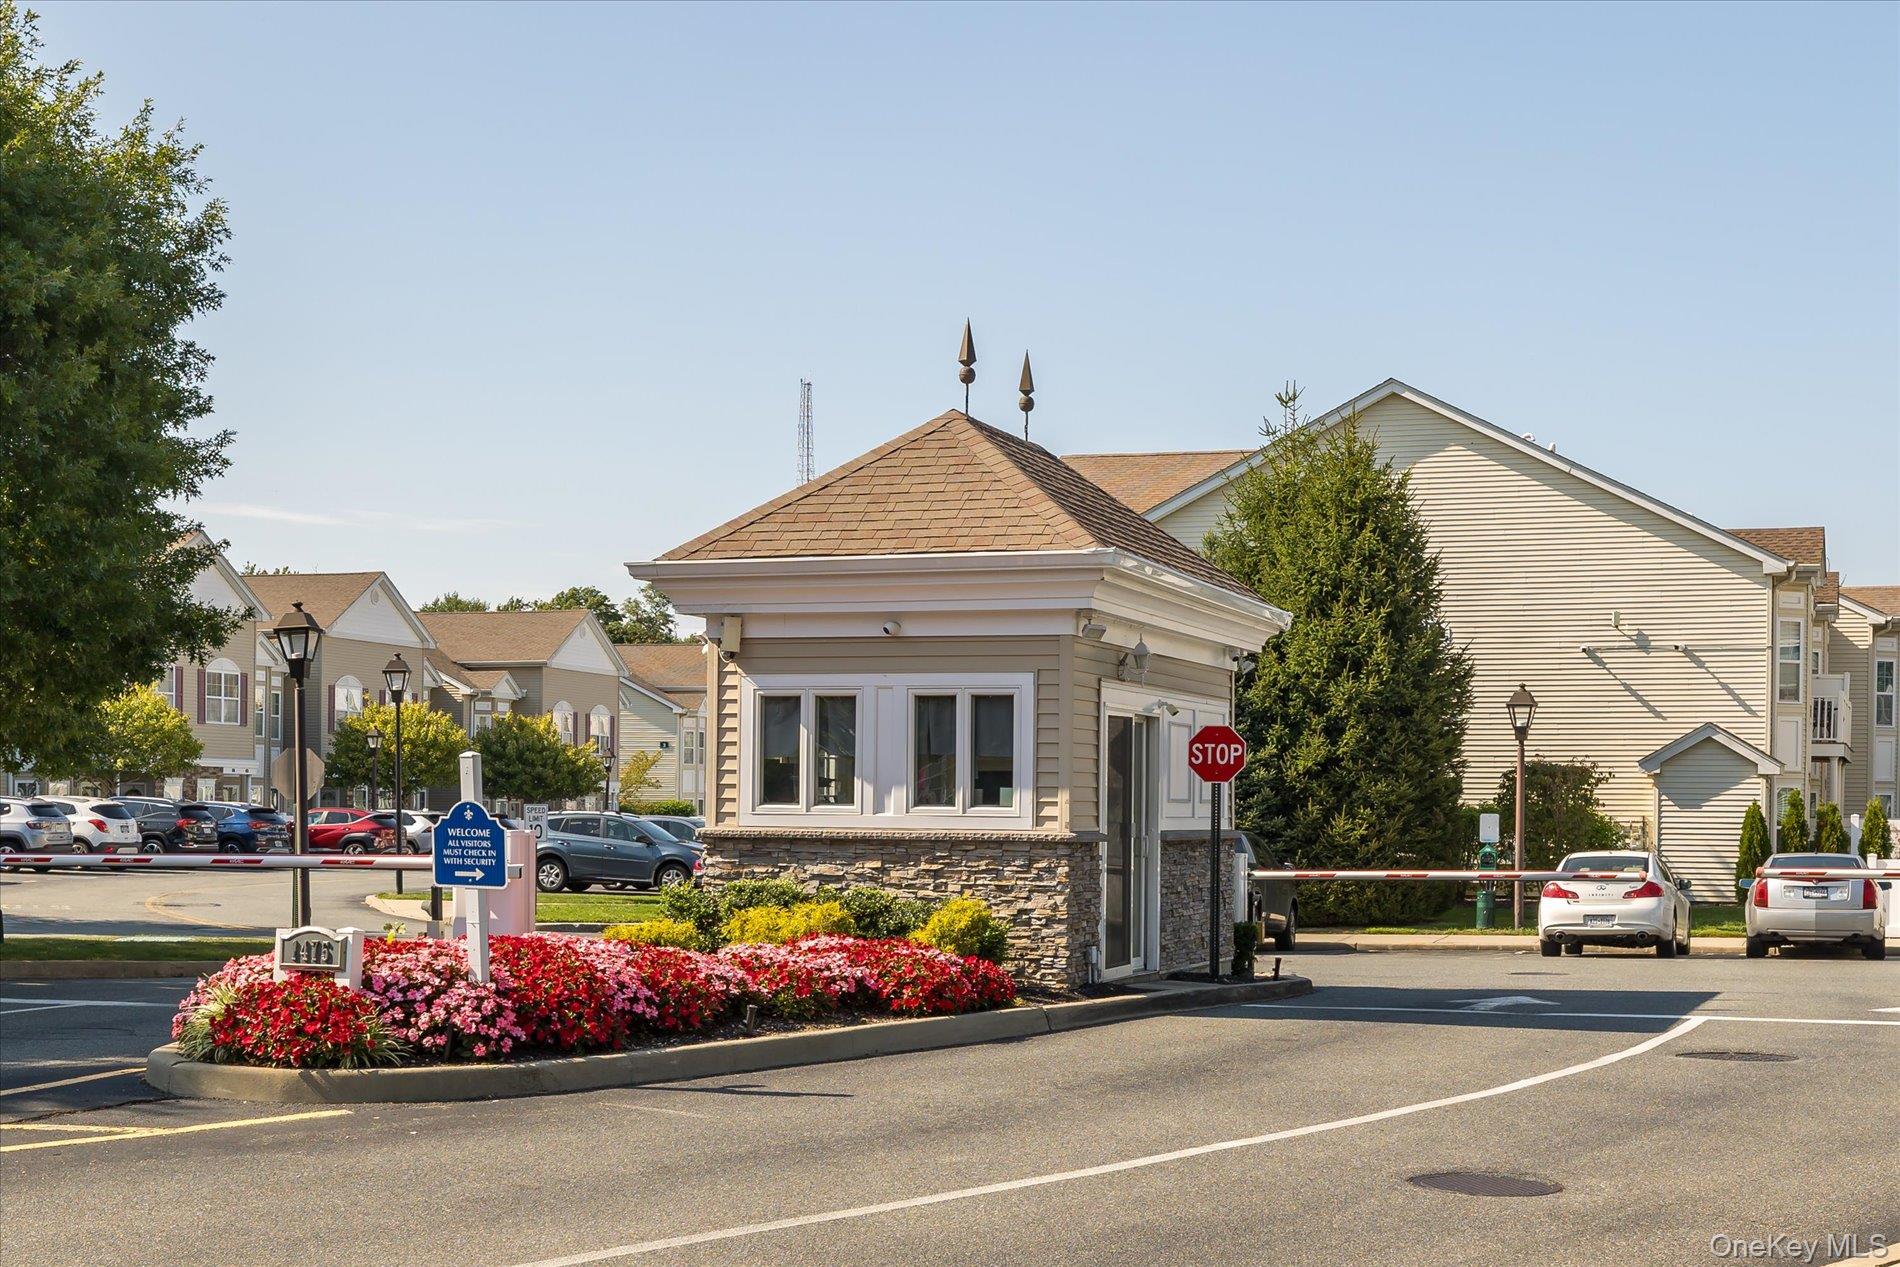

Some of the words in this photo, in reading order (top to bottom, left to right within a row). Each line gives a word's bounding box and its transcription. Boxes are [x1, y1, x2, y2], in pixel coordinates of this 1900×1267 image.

[1191, 743, 1243, 765] STOP
[526, 806, 546, 814] SPEED
[447, 828, 491, 838] WELCOME
[448, 839, 460, 847] ALL
[460, 840, 491, 848] VISITORS
[443, 848, 462, 856] MUST
[463, 849, 487, 857] CHECK
[443, 857, 463, 865] WITH
[464, 858, 497, 866] SECURITY
